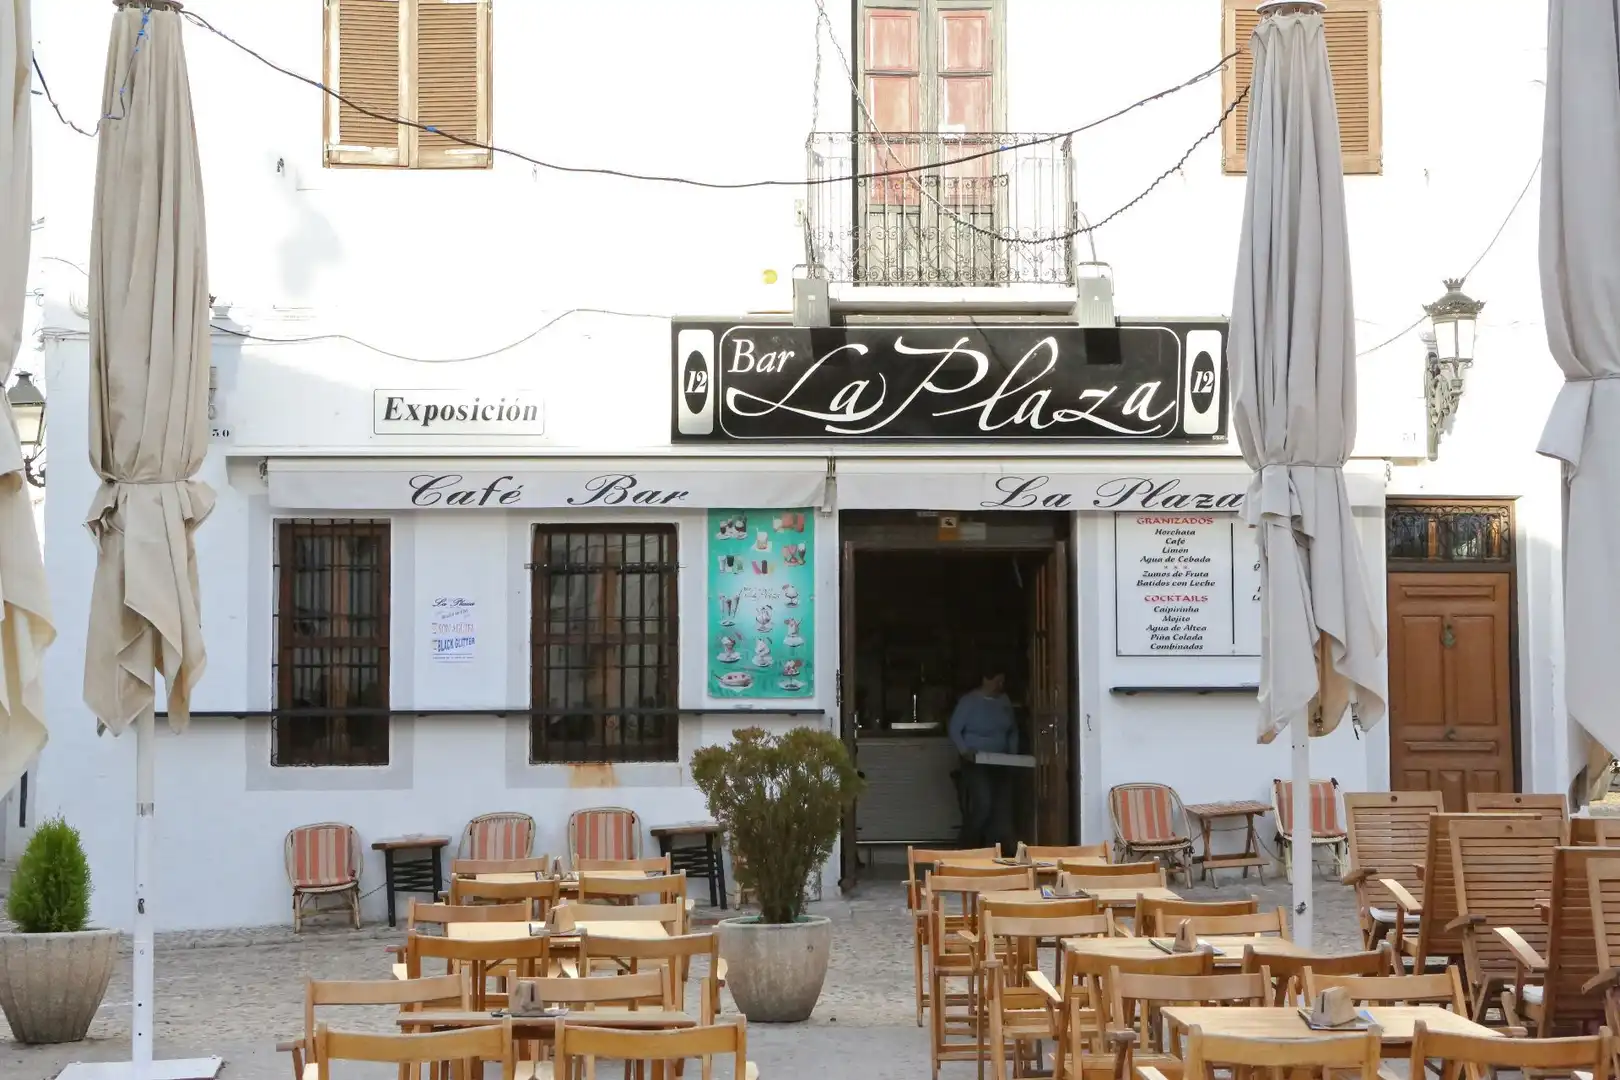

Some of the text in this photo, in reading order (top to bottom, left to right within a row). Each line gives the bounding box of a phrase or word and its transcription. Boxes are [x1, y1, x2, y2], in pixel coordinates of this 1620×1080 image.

[727, 338, 795, 373] Bar
[686, 370, 708, 394] 12
[725, 335, 1177, 434] La Plaza
[1192, 370, 1214, 394] 12
[382, 396, 538, 427] Exposición
[408, 473, 689, 507] Café Bar
[980, 475, 1245, 509] La Plaza
[1136, 517, 1214, 525] GRANIZADOS
[1154, 528, 1196, 536] Horchata
[1139, 555, 1211, 564] Agua de Cebada
[1142, 570, 1209, 578] Zumos de Fruta
[1136, 579, 1170, 587] Batidos
[1189, 579, 1216, 587] Leche
[1144, 594, 1209, 602] COCKTAILS
[1153, 605, 1199, 614] Caipirinha
[1161, 615, 1191, 623] Mojito
[1145, 624, 1169, 633] Agua
[1172, 633, 1203, 641] Colada
[1150, 642, 1204, 650] Combinados
